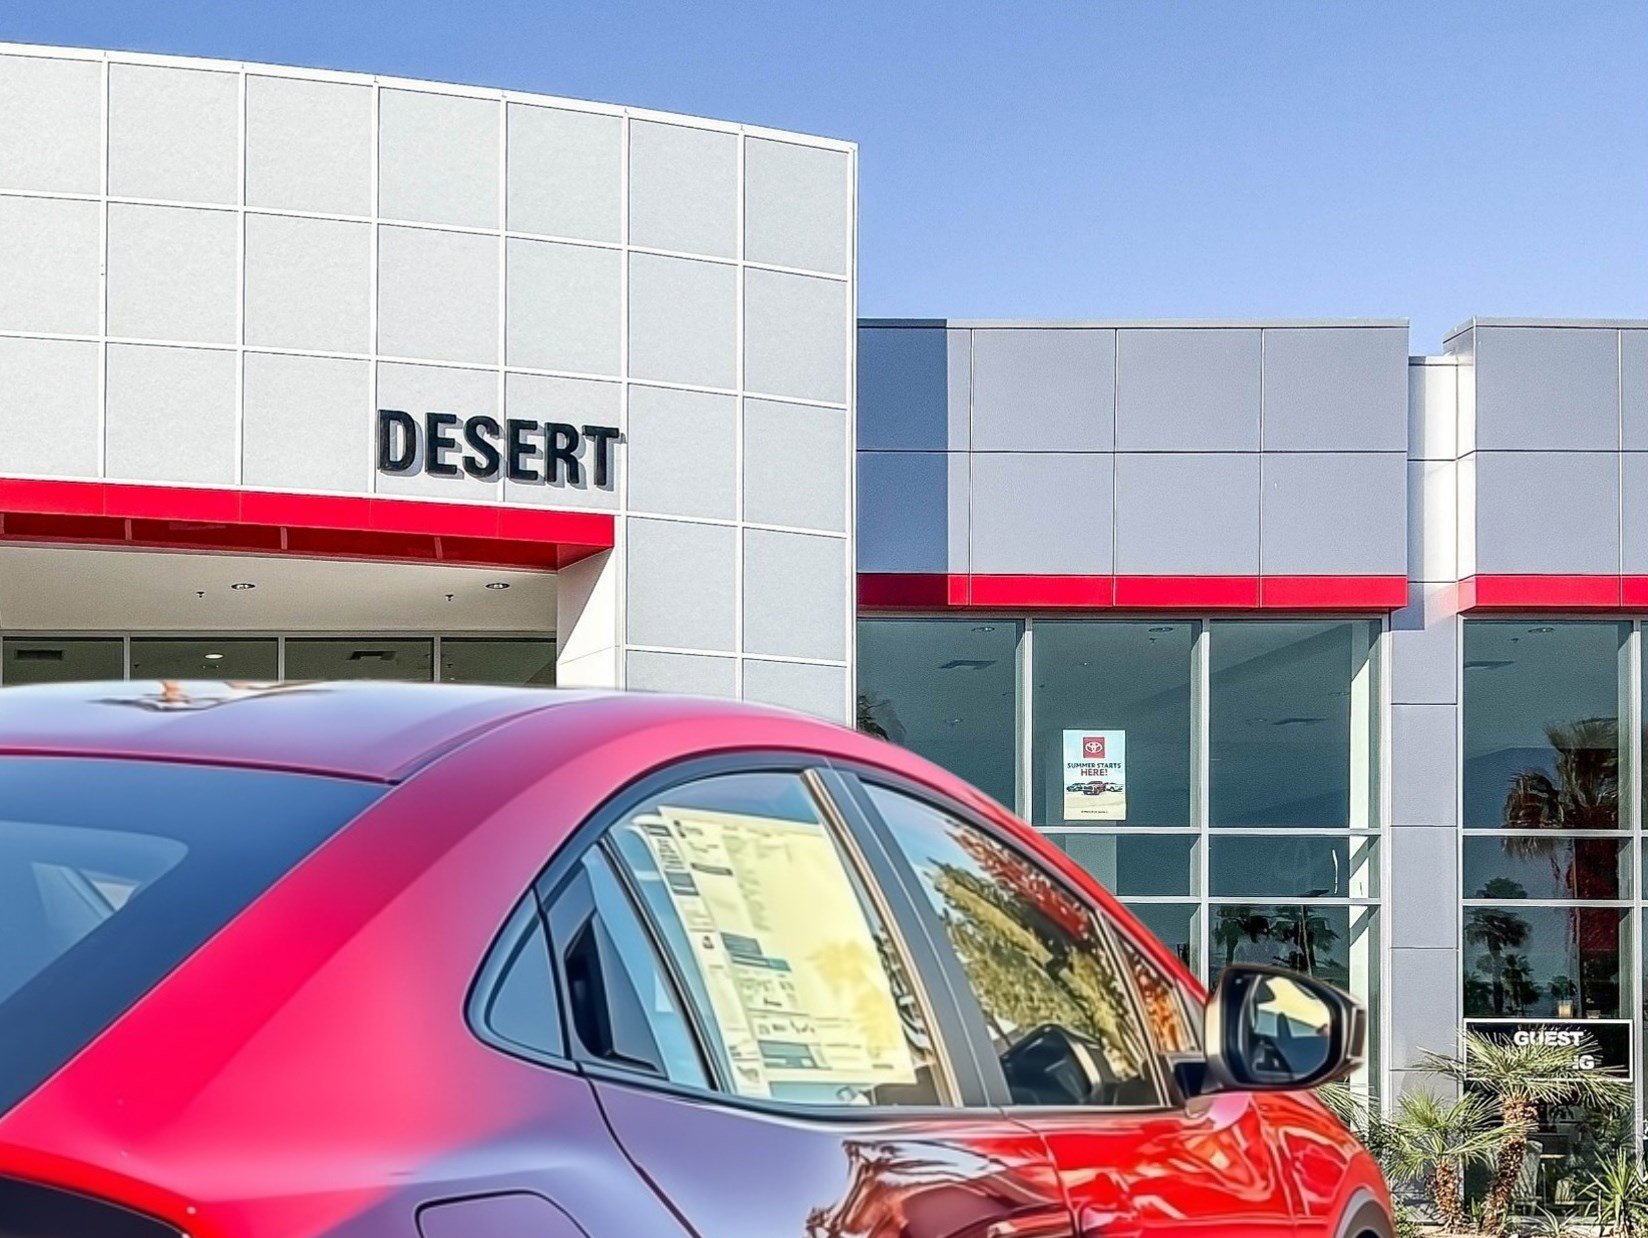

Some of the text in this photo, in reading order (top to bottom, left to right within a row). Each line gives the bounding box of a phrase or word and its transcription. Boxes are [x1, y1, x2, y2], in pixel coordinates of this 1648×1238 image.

[377, 409, 620, 486] DESERT
[1080, 768, 1108, 777] HERE!
[1513, 1031, 1584, 1047] GUEST
